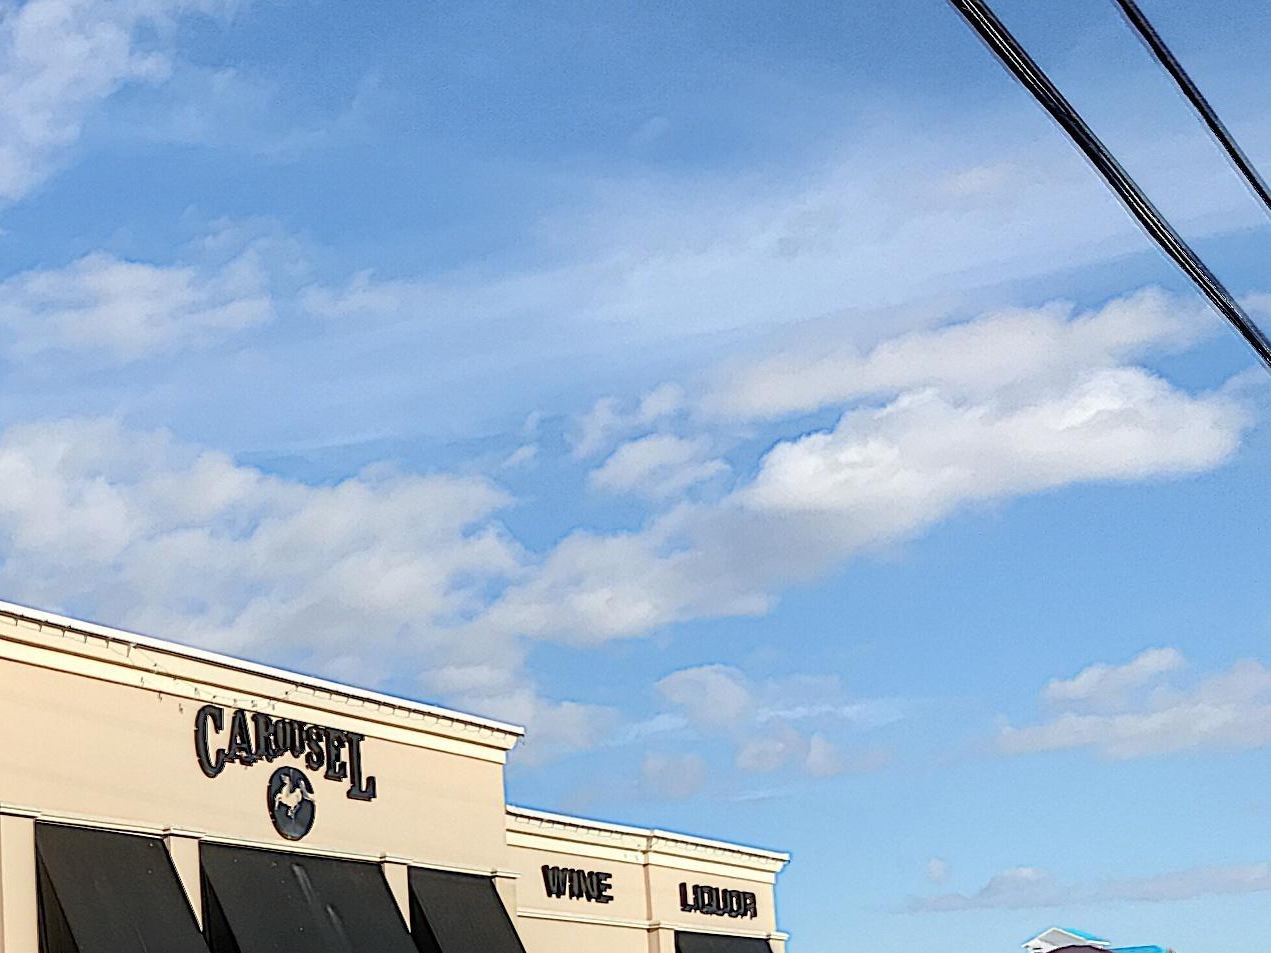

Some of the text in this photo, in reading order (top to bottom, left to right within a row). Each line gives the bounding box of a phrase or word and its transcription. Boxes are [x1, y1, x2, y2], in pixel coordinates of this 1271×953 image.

[194, 704, 377, 801] CAROUSEL
[541, 865, 614, 904] WINE
[679, 882, 758, 920] LIQUOR
